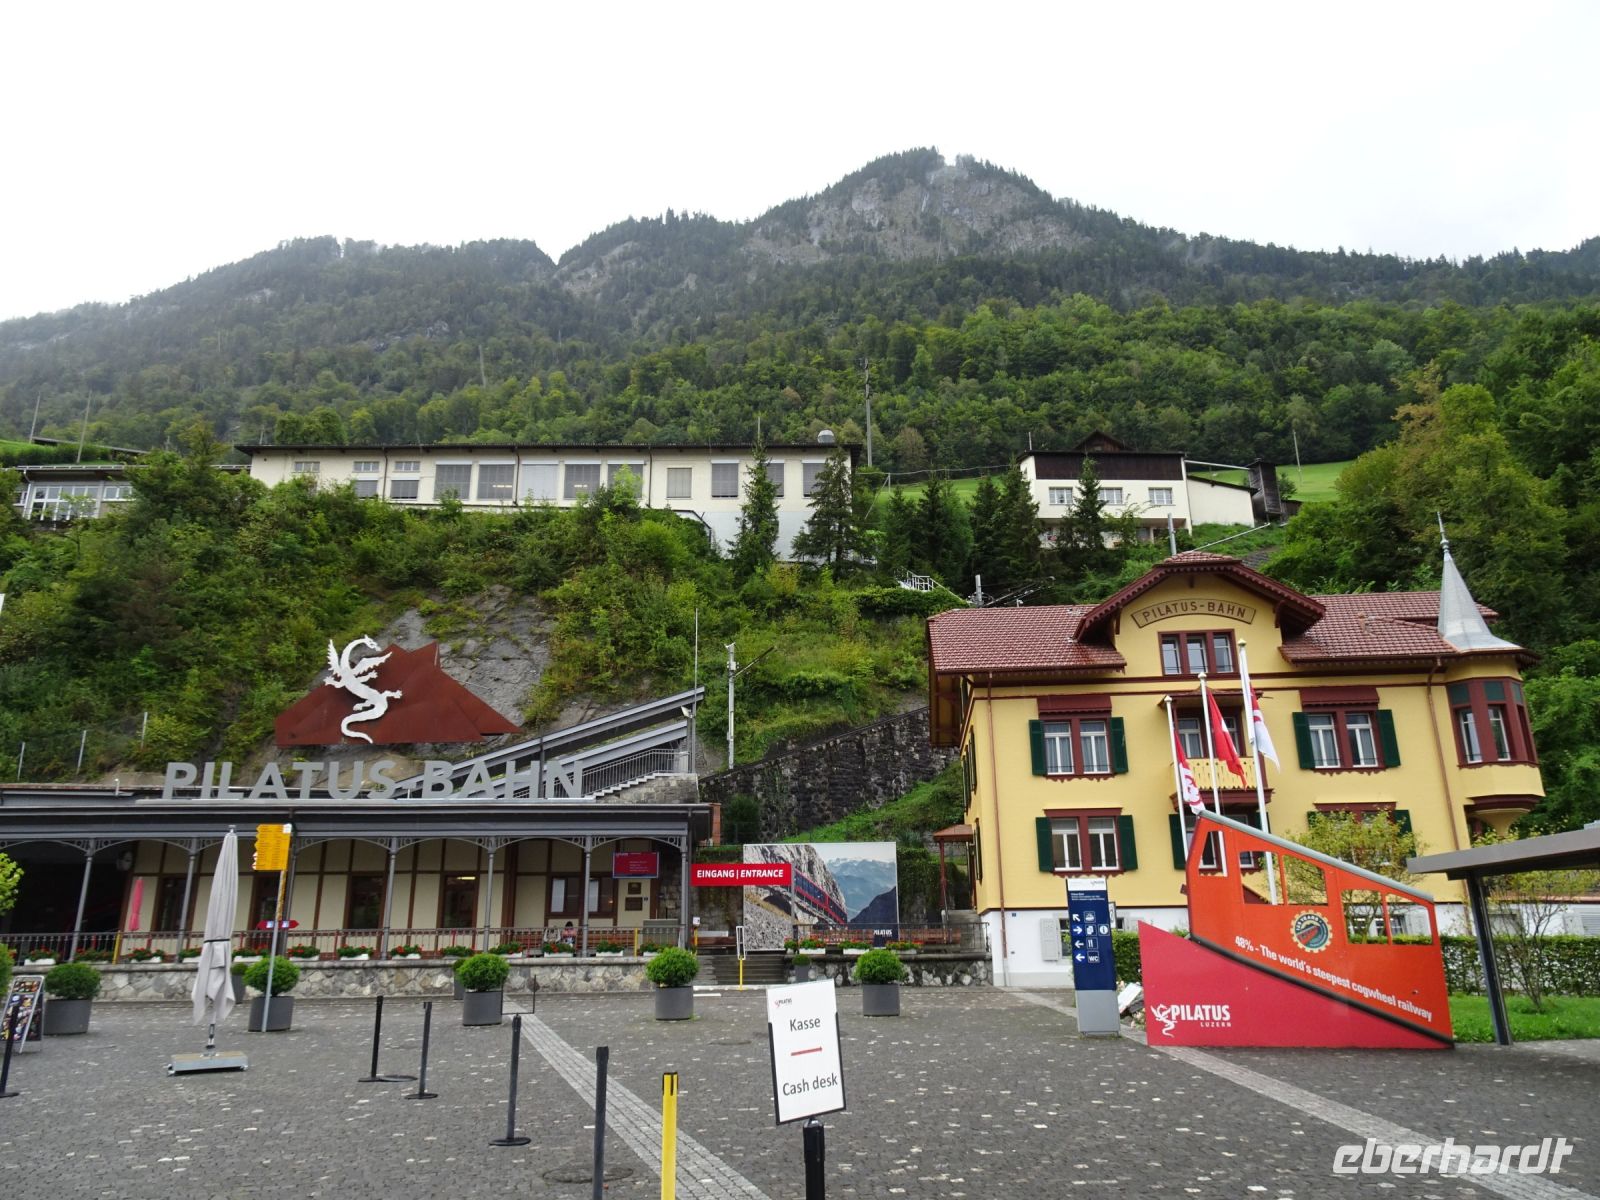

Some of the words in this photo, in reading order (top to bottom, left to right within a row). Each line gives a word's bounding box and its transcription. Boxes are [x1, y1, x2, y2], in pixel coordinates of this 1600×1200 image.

[1142, 601, 1246, 622] PILATUS-BAHN
[161, 760, 396, 800] PILATUS
[421, 760, 584, 800] BAHN
[696, 869, 735, 878] EINGANG
[740, 869, 784, 878] ENTRANCE
[1235, 935, 1254, 952] 48%
[1260, 944, 1277, 961] The
[1278, 954, 1312, 974] world's
[1313, 966, 1351, 989] steepest
[1352, 981, 1396, 1007] cogwheel
[1397, 999, 1432, 1022] railway
[1170, 1004, 1231, 1021] PILATUS
[789, 1017, 821, 1032] Kasse
[782, 1078, 810, 1096] Cash
[812, 1072, 838, 1090] desk
